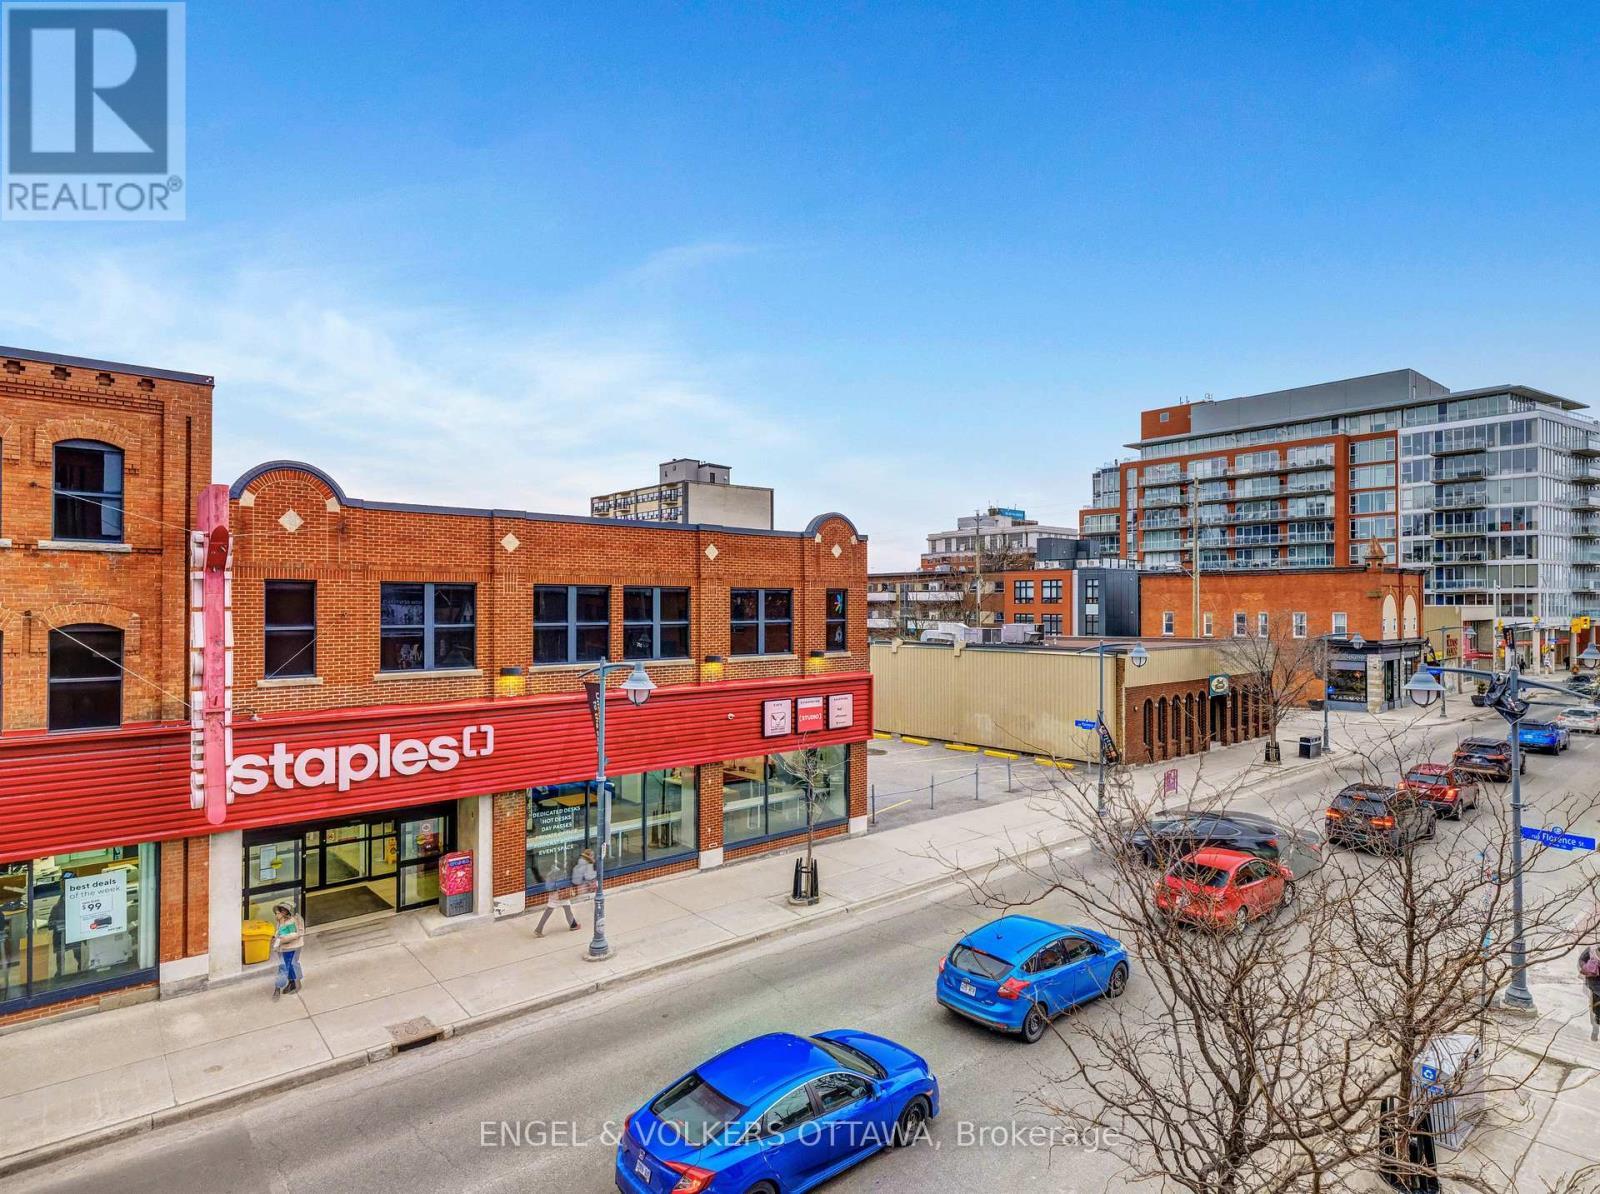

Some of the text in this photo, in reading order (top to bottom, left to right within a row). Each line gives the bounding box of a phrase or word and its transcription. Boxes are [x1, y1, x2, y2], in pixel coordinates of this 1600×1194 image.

[230, 733, 460, 795] staples
[533, 809, 563, 818] DEDICATED
[552, 822, 572, 830] PASSES
[1542, 832, 1577, 846] Florence
[538, 847, 557, 856] EVENT
[92, 879, 117, 887] deals
[98, 886, 120, 894] week
